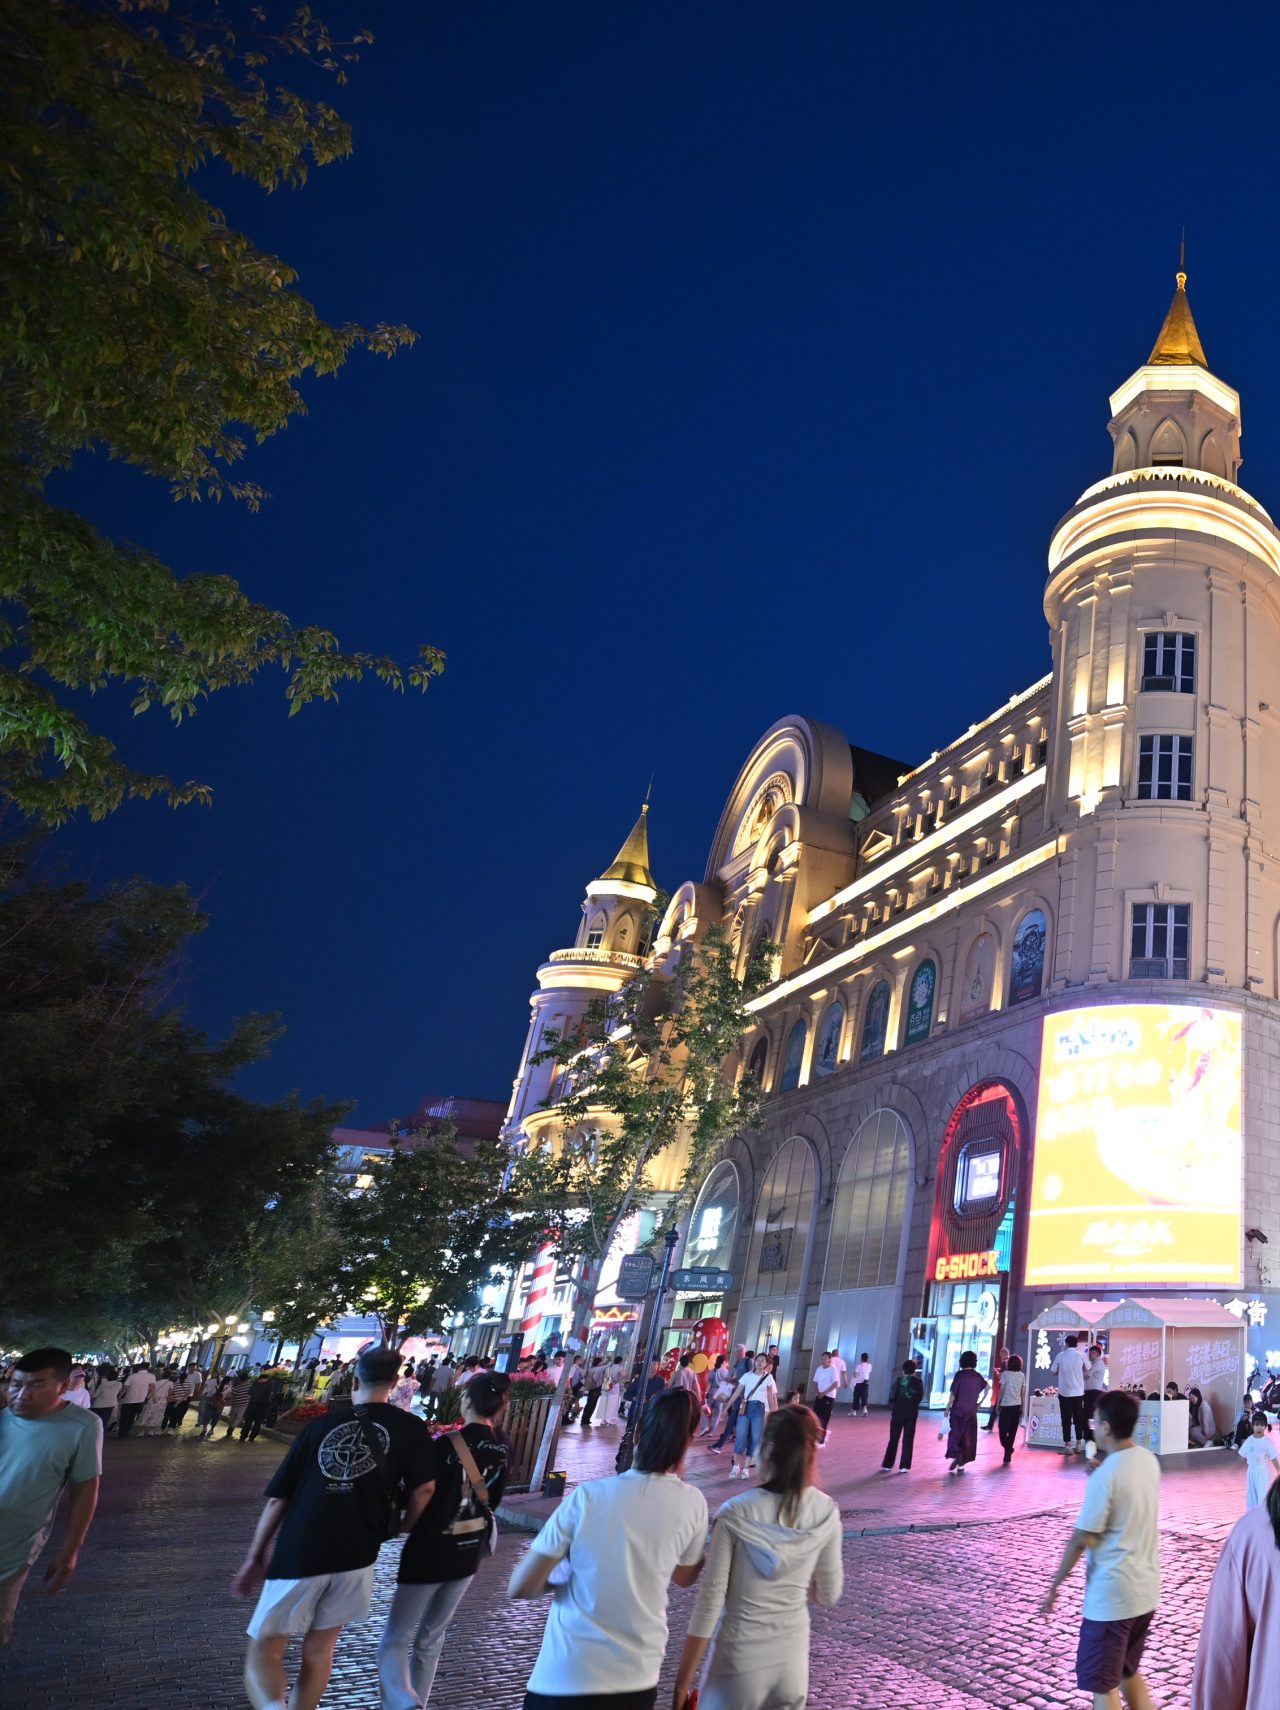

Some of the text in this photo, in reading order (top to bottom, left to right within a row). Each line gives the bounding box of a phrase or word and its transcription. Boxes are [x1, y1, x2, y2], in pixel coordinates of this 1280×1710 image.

[935, 1251, 1000, 1281] G-SHOCK
[683, 1274, 725, 1284] 东风街
